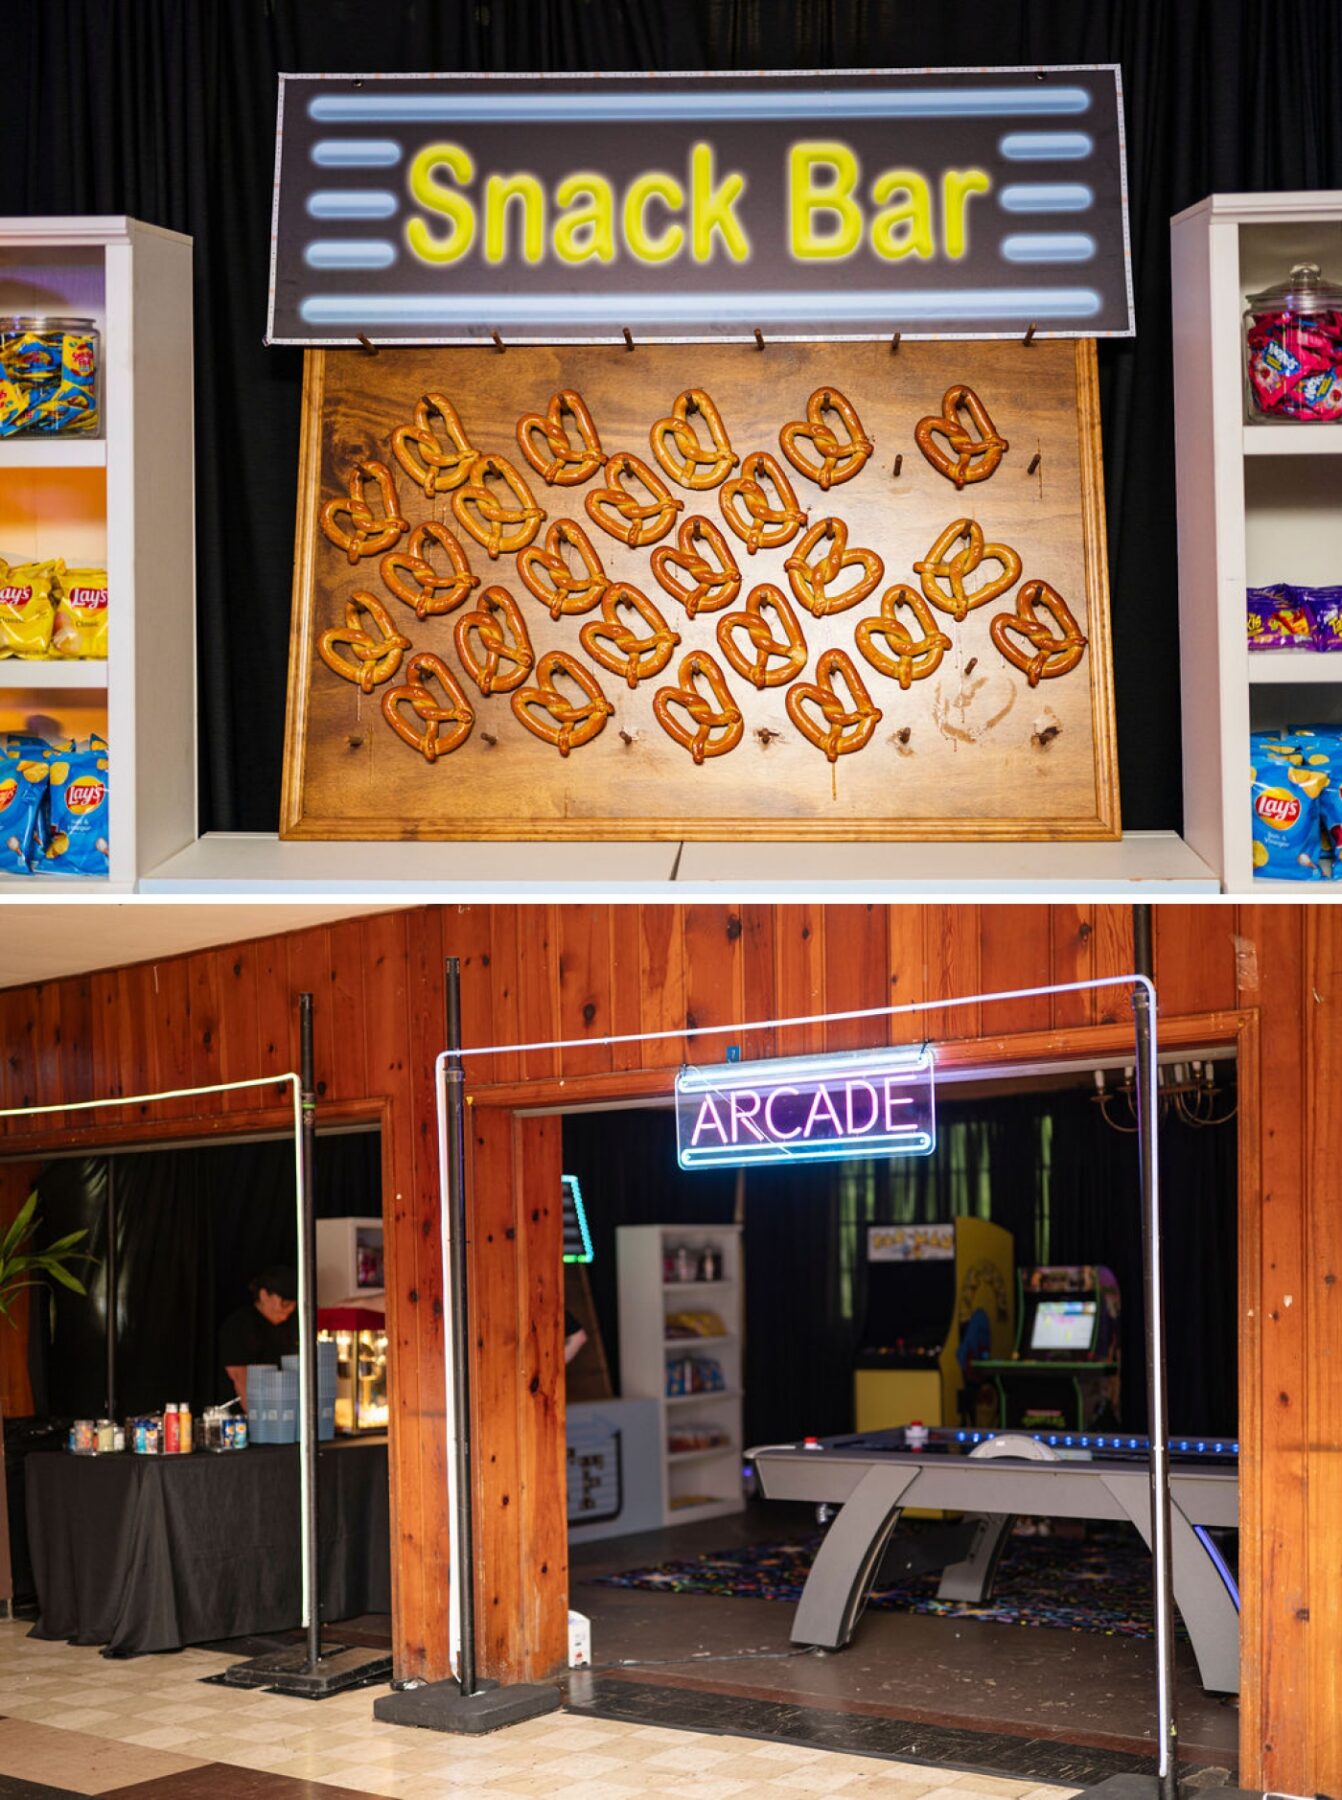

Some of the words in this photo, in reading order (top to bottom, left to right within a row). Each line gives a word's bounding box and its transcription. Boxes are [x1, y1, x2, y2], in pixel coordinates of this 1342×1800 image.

[406, 142, 750, 265] Snack
[789, 141, 990, 260] Bar
[68, 784, 102, 806] Lay's
[1258, 796, 1298, 821] Lay's
[691, 1074, 919, 1146] ARCADE
